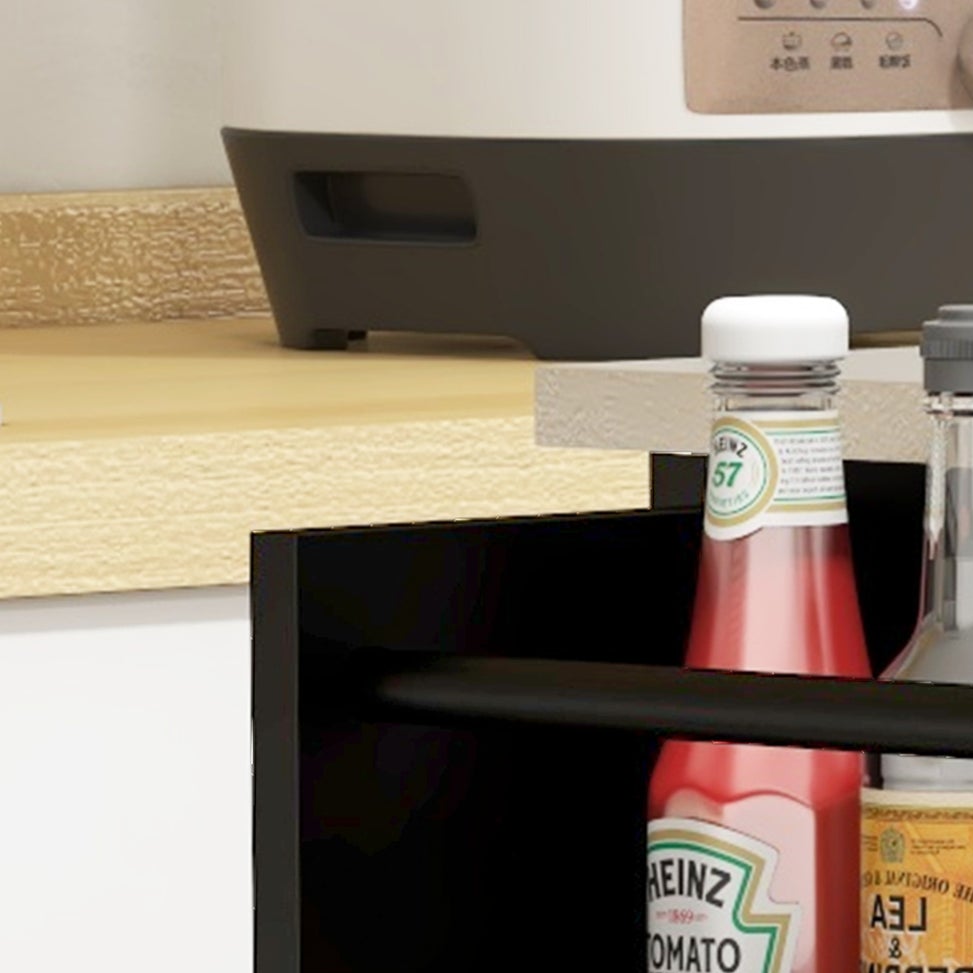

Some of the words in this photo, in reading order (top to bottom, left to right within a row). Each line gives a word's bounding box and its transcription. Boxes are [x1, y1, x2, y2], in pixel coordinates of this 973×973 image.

[713, 437, 748, 458] EINZ
[712, 461, 743, 488] 57
[647, 933, 741, 973] OMATO
